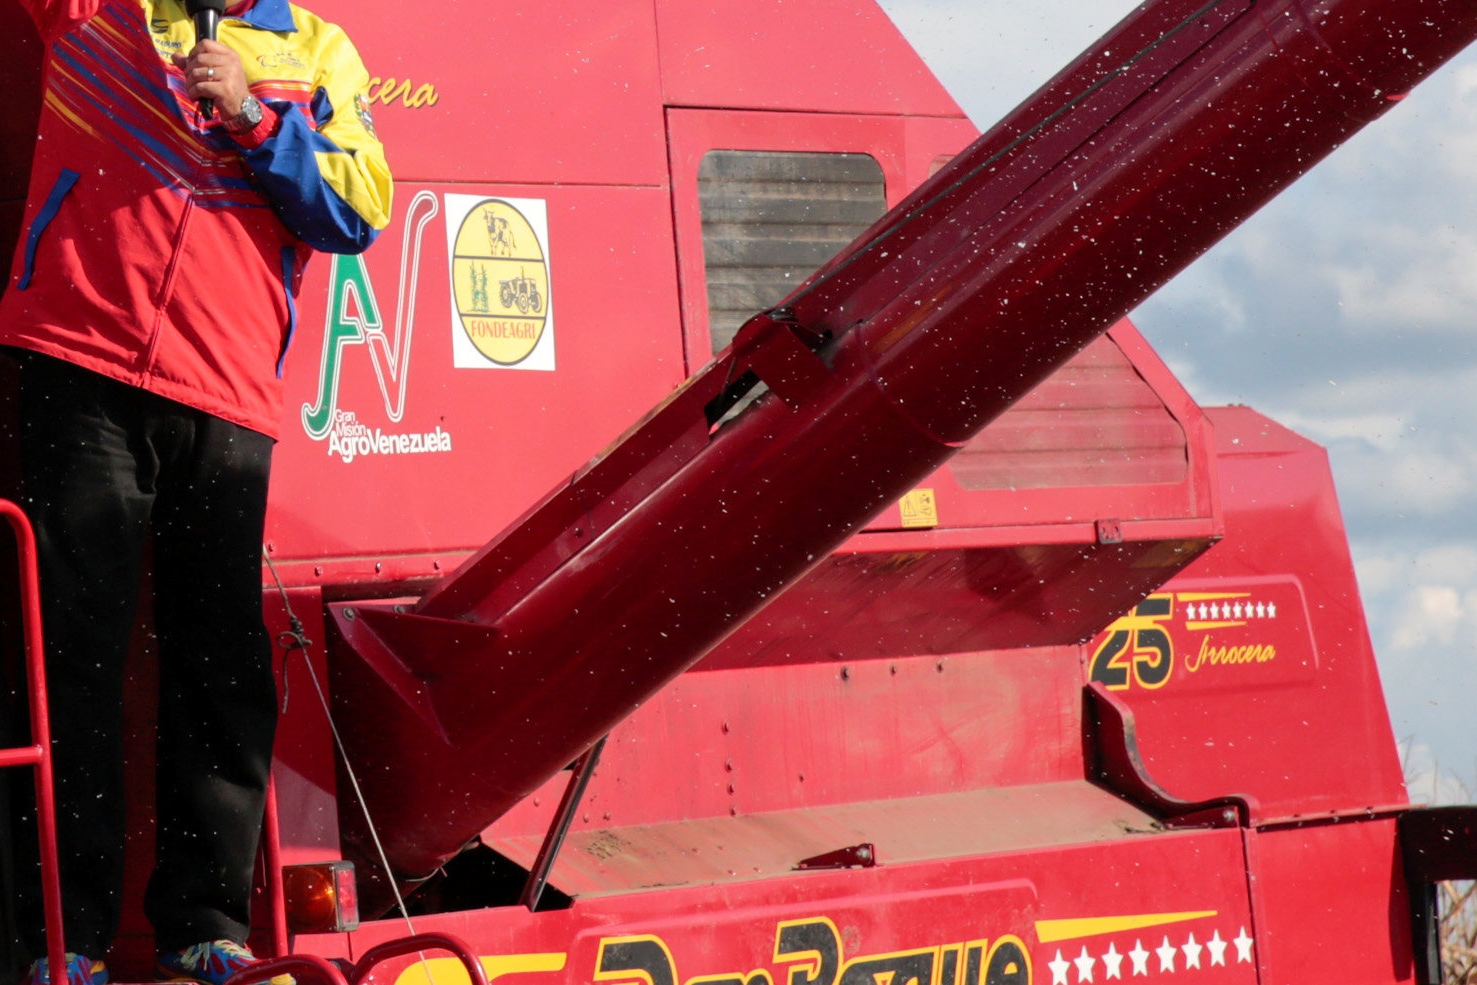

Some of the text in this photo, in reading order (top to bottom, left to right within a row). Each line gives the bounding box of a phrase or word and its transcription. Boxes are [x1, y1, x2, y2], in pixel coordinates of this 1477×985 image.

[471, 320, 536, 339] FONDEAGRI
[334, 409, 356, 423] Gran
[336, 421, 367, 437] Misión
[327, 425, 452, 464] AgroVenezuela
[1088, 592, 1174, 691] 25
[1184, 634, 1276, 673] Arrocera
